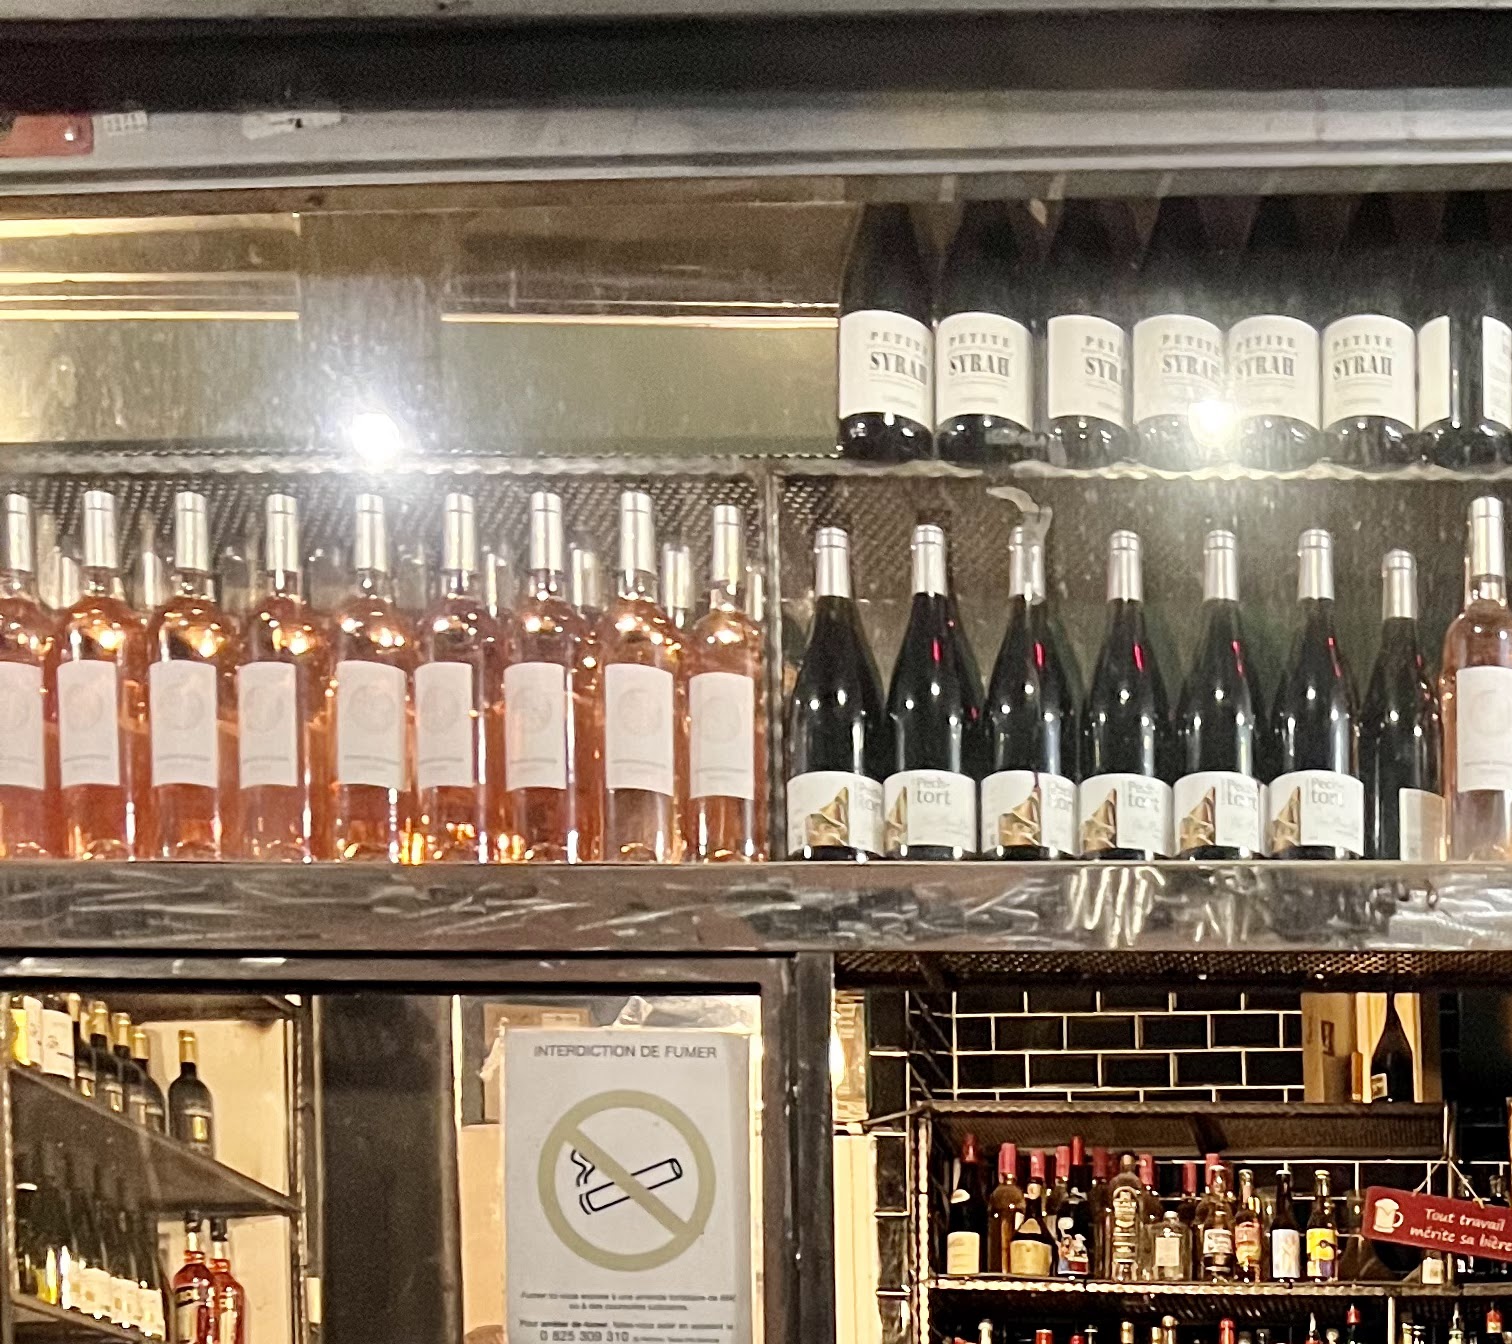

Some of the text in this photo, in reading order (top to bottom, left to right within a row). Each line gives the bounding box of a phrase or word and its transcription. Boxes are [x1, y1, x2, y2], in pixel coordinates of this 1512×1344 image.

[950, 352, 1010, 377] SYRAH
[1333, 355, 1393, 381] SYRAH
[534, 1045, 717, 1059] INTERDICTION DE FUMER
[1425, 1208, 1506, 1232] Tout travail
[1410, 1226, 1512, 1252] mérite sa bière
